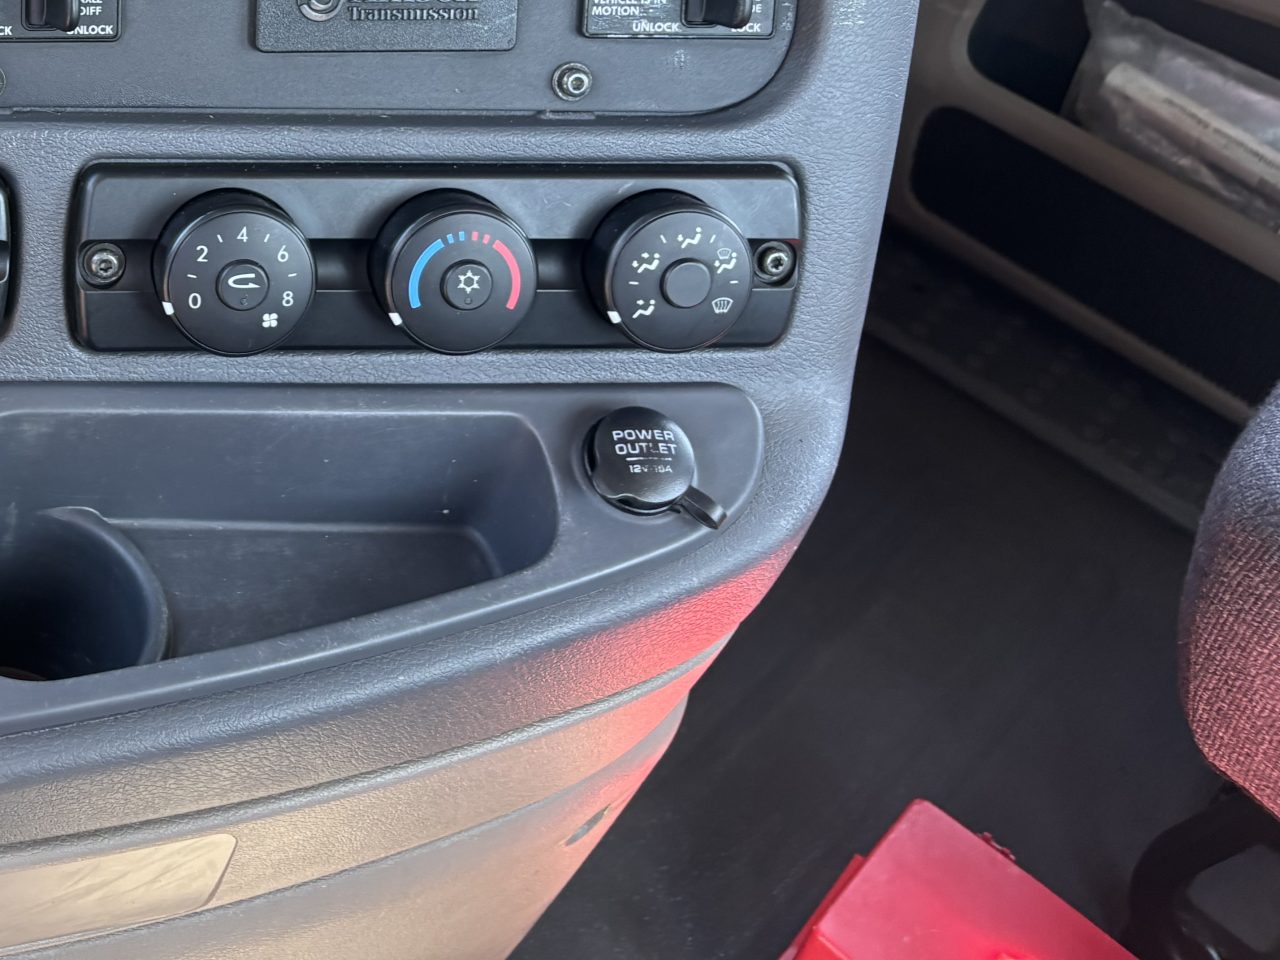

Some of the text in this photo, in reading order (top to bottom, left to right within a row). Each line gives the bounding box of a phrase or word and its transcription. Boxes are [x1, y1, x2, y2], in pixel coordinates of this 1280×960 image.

[348, 6, 478, 20] Transmission
[66, 24, 113, 34] NLOCK
[633, 22, 680, 32] UNLOCK
[236, 226, 248, 243] 4
[196, 245, 209, 262] 2
[277, 245, 289, 262] 6
[188, 293, 201, 309] 0
[282, 291, 294, 307] 8
[612, 429, 675, 441] POWER
